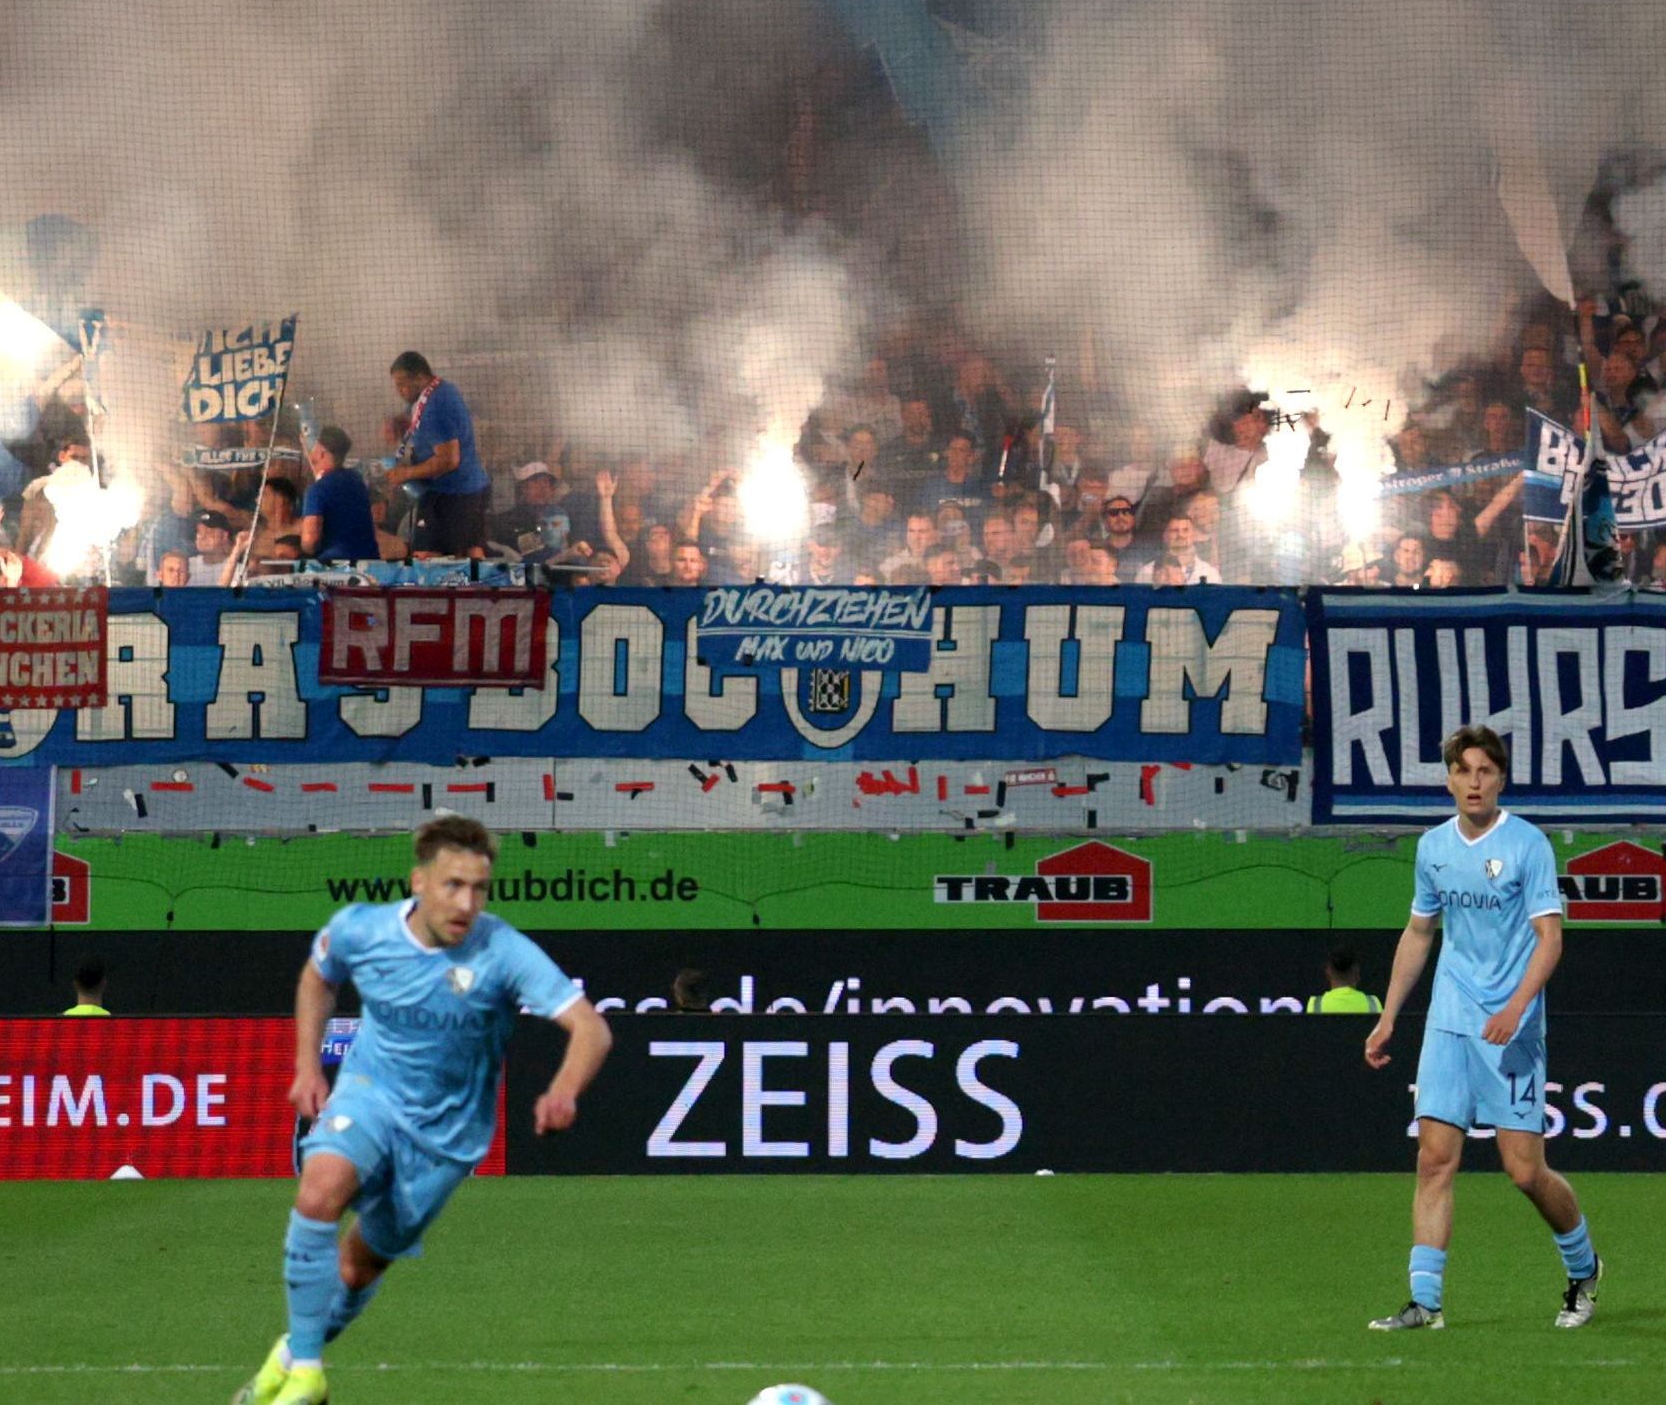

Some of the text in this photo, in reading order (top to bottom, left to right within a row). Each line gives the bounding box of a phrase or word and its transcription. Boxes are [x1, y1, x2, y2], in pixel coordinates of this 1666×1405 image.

[199, 342, 292, 386] LIEBE
[189, 378, 284, 423] DICH
[702, 590, 934, 630] DURCHZIEHEN
[333, 597, 524, 673] RFM
[937, 877, 1129, 901] TRAUB
[1558, 876, 1659, 901] AUB
[647, 1039, 1024, 1159] ZEISS
[1508, 1072, 1538, 1106] 14
